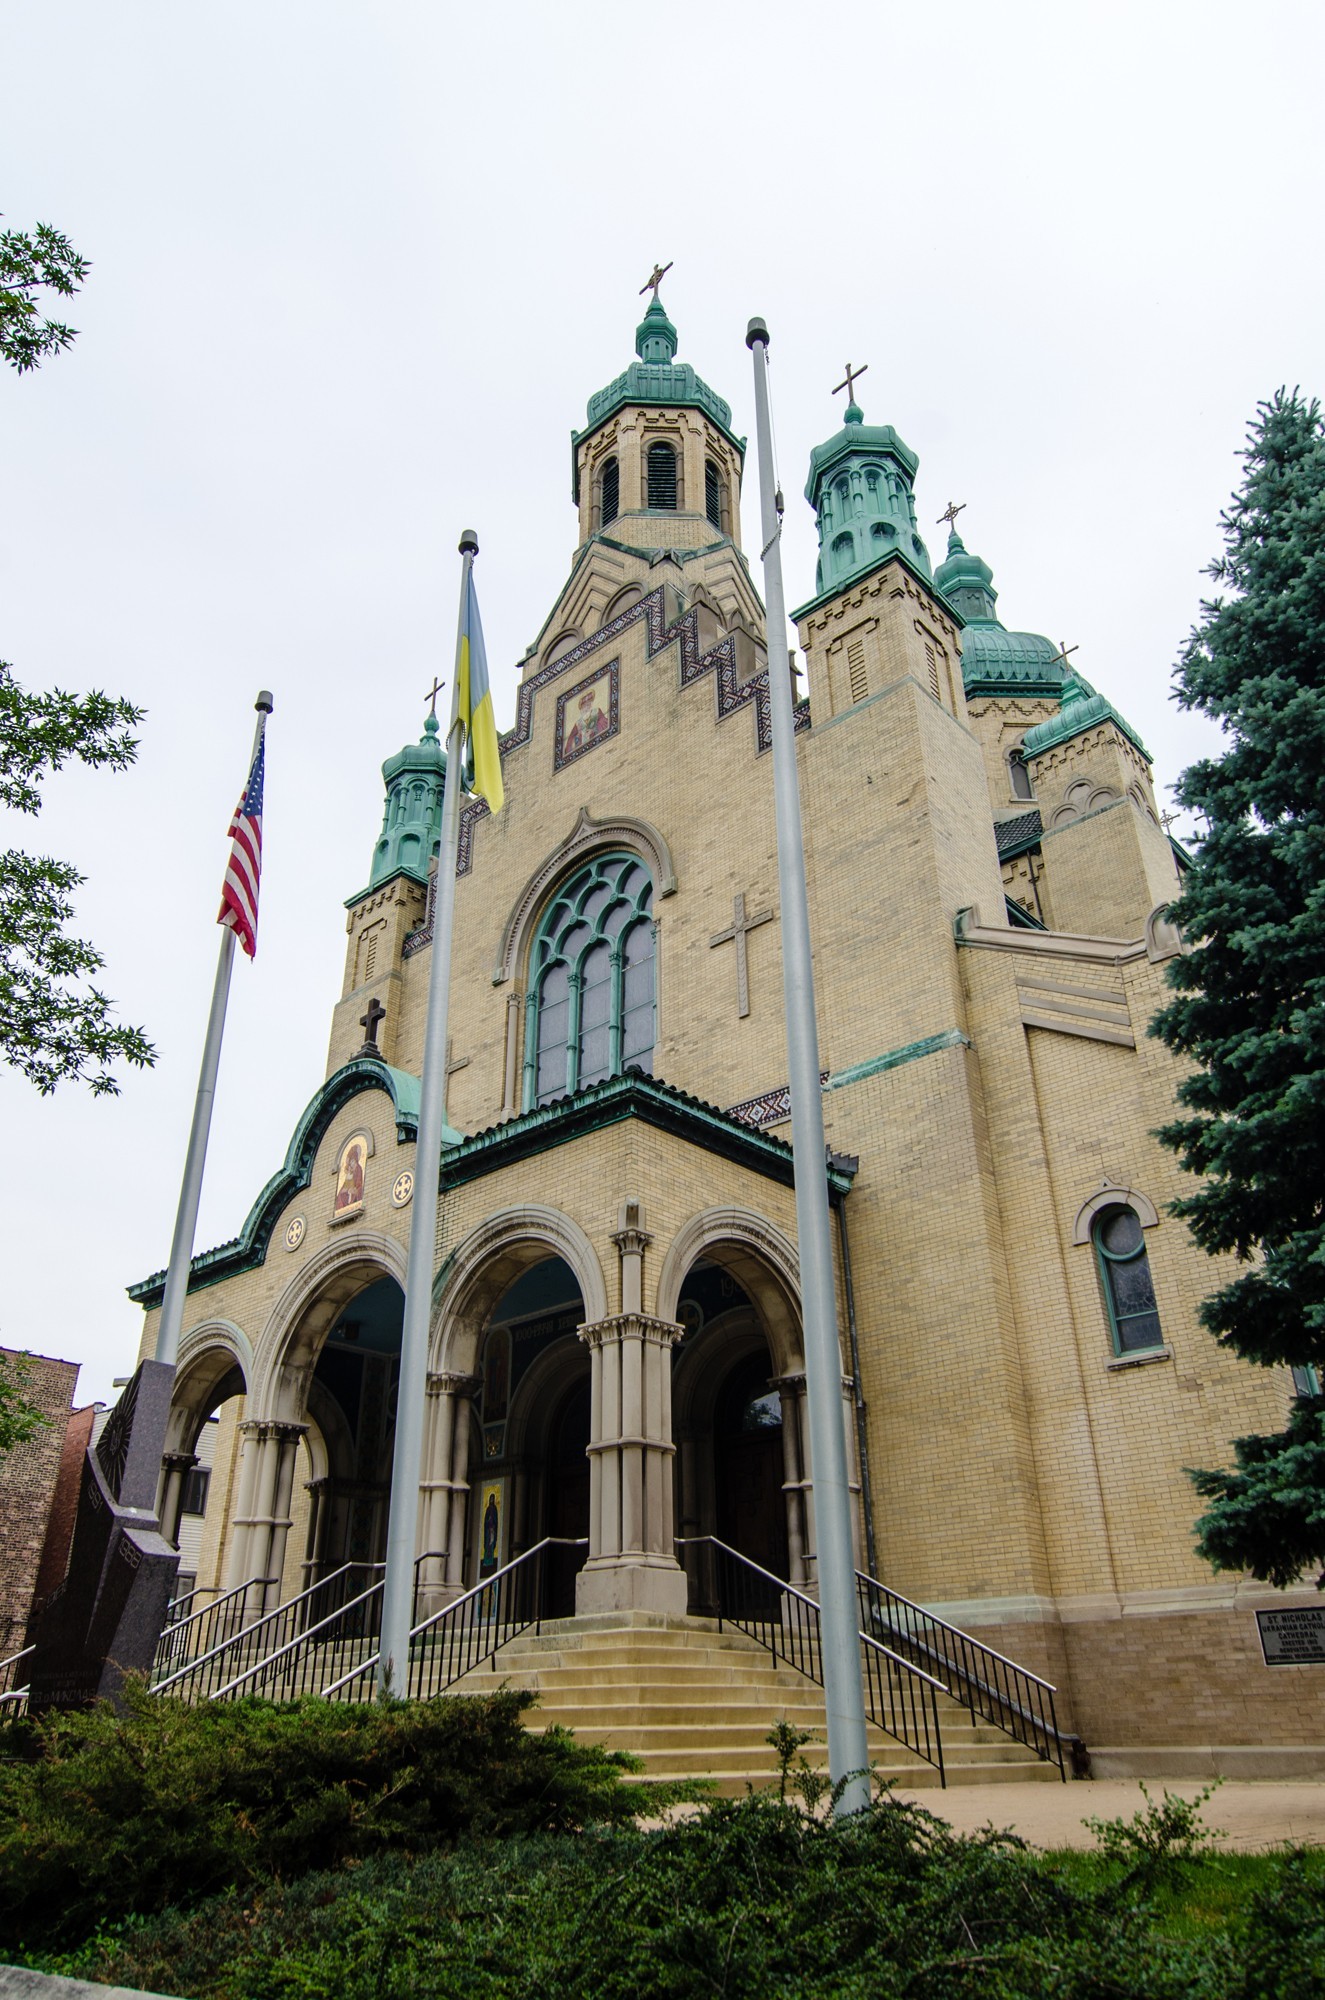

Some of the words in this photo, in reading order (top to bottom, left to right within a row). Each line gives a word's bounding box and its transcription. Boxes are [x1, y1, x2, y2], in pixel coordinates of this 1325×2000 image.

[118, 1537, 142, 1569] 1988
[1281, 1613, 1322, 1623] NICHOLAS
[1262, 1624, 1298, 1632] UKRAINIAN
[1278, 1631, 1318, 1639] CATHEDRAL
